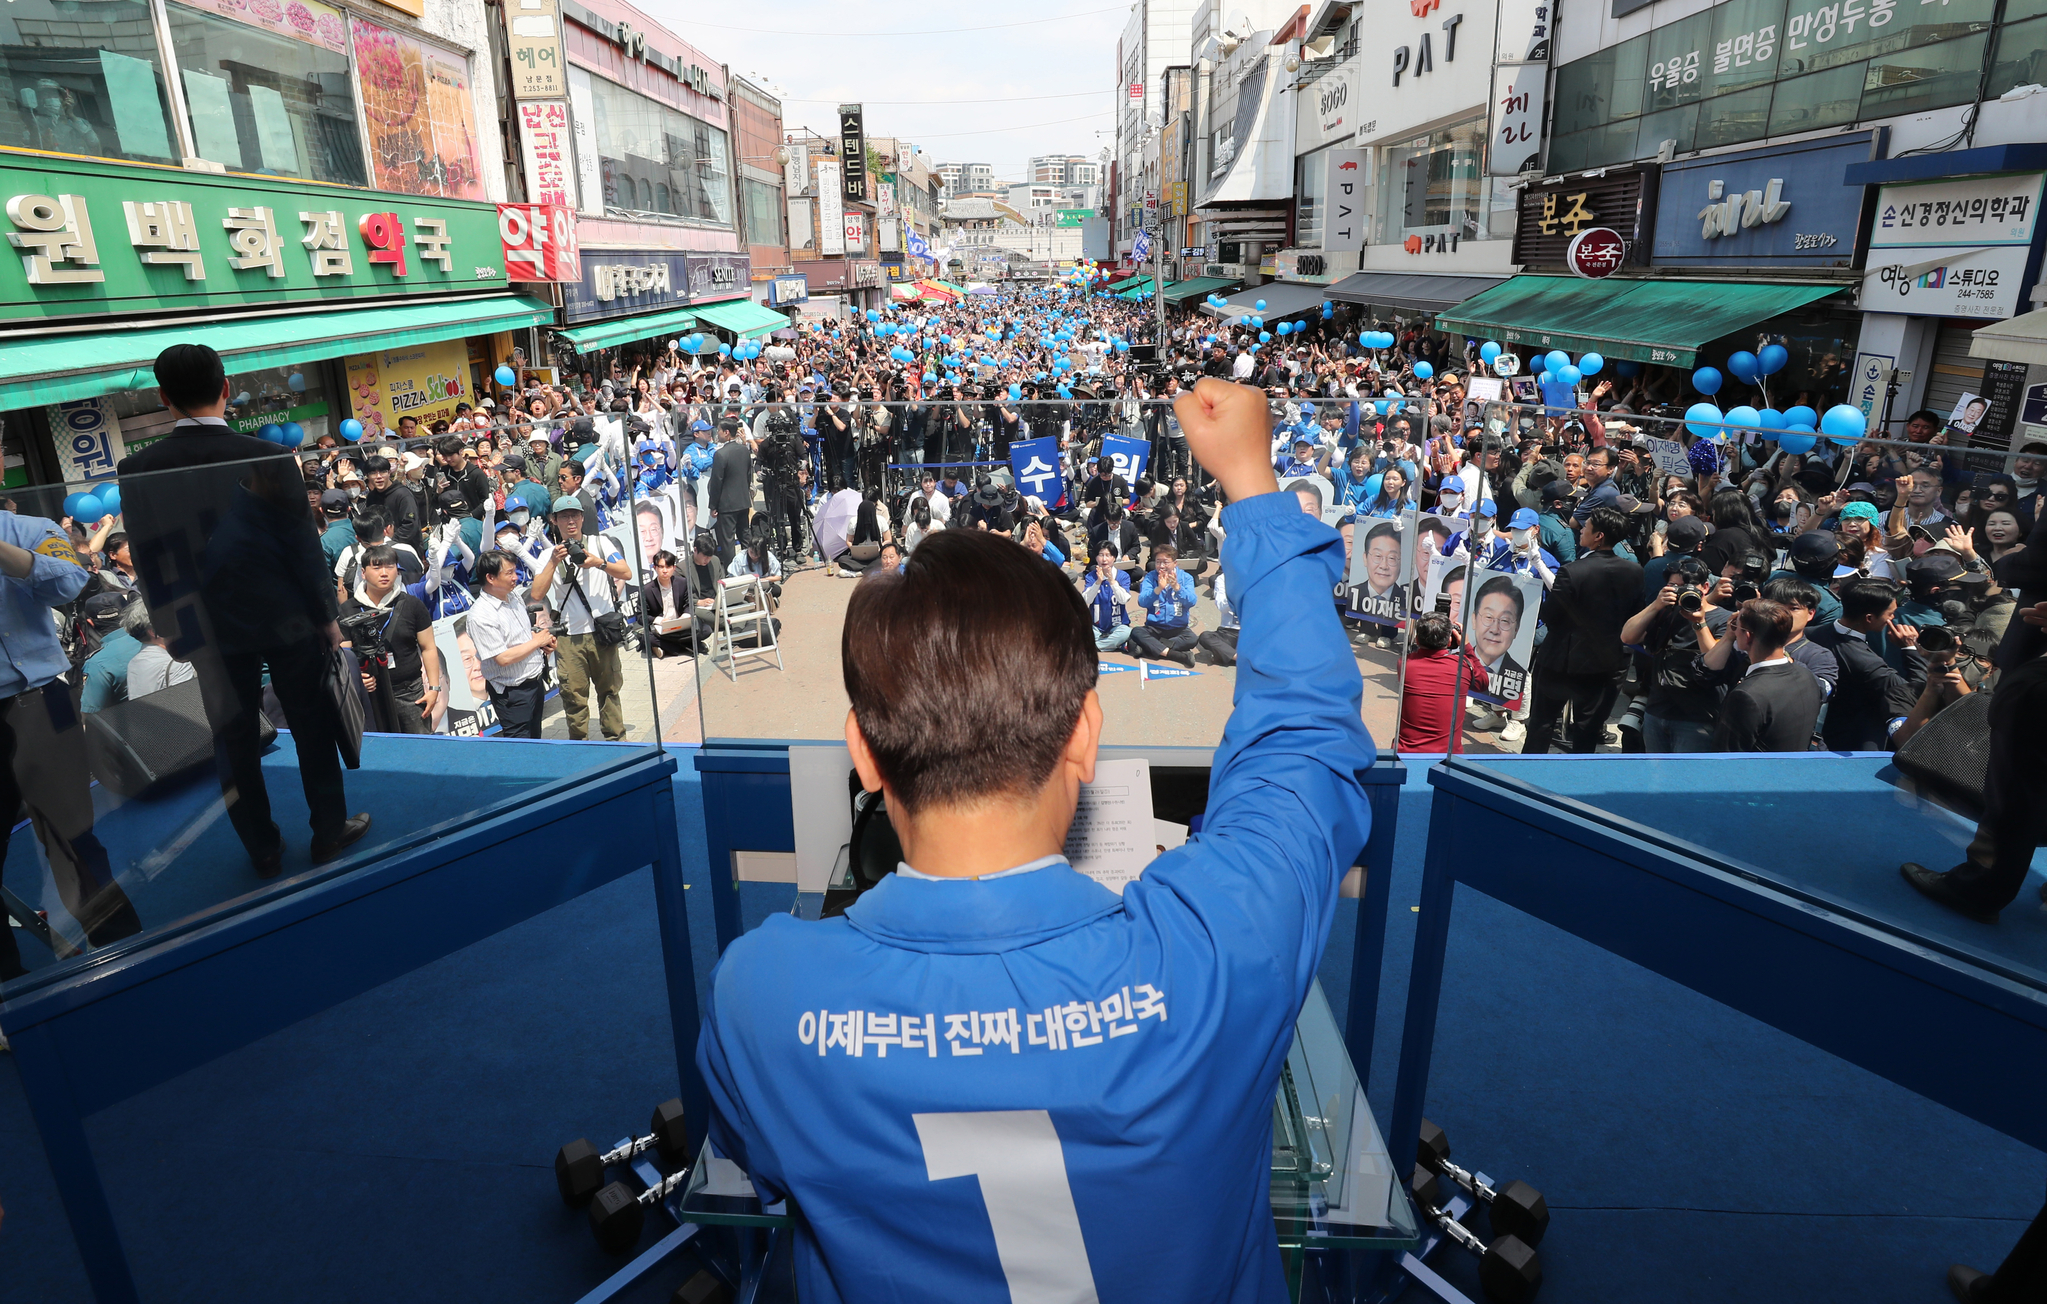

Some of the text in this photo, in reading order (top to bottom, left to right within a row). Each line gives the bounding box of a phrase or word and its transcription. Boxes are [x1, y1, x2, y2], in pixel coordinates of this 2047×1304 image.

[516, 47, 557, 69] 헤어
[1392, 14, 1463, 87] PAT
[1534, 49, 1546, 58] 2F
[1649, 50, 1700, 92] 우울증
[1713, 25, 1776, 74] 불면증
[1321, 82, 1348, 116] SOGO
[843, 117, 864, 197] 스텐드바
[1525, 162, 1535, 171] 1F
[1338, 182, 1354, 240] PAT
[499, 206, 548, 278] 약
[846, 226, 862, 244] 약
[1424, 232, 1461, 253] PAT
[2010, 227, 2026, 238] 의원
[1297, 254, 1325, 276] SOGO
[1577, 243, 1622, 268] 본죽
[1948, 269, 2000, 288] 스튜디오
[1957, 289, 1995, 299] 244-7585
[389, 379, 415, 392] 피자스쿨
[391, 390, 427, 413] PIZZA
[239, 411, 290, 432] PHARMACY
[1646, 438, 1681, 455] 이재명
[1020, 455, 1056, 493] 수
[1661, 455, 1691, 475] 필승
[1351, 587, 1360, 611] 1
[1503, 668, 1524, 680] 지금은
[1486, 673, 1522, 701] 재명
[798, 983, 1168, 1058] 이제부터 진짜 대한민국
[912, 1109, 1099, 1304] 1
